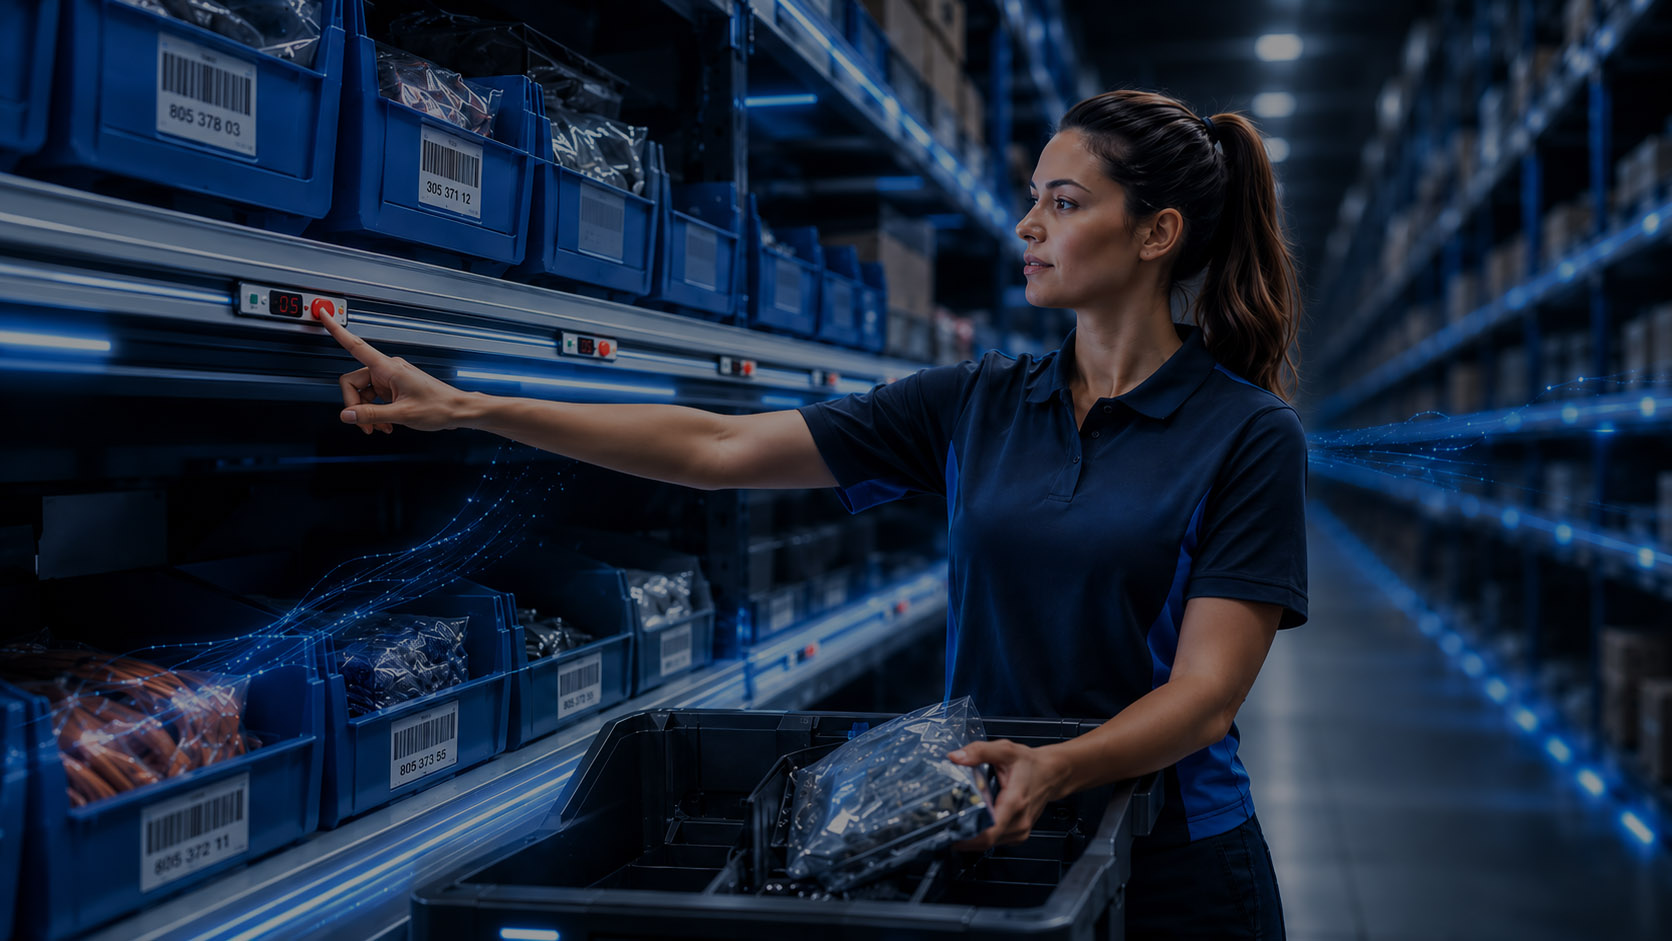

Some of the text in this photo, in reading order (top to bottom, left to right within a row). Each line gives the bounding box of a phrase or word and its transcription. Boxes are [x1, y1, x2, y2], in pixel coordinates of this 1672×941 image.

[169, 103, 241, 137] 805 378 03
[426, 180, 471, 205] 305 371 12
[280, 295, 299, 314] 05
[400, 748, 447, 776] 805 373 55
[215, 833, 229, 851] 11
